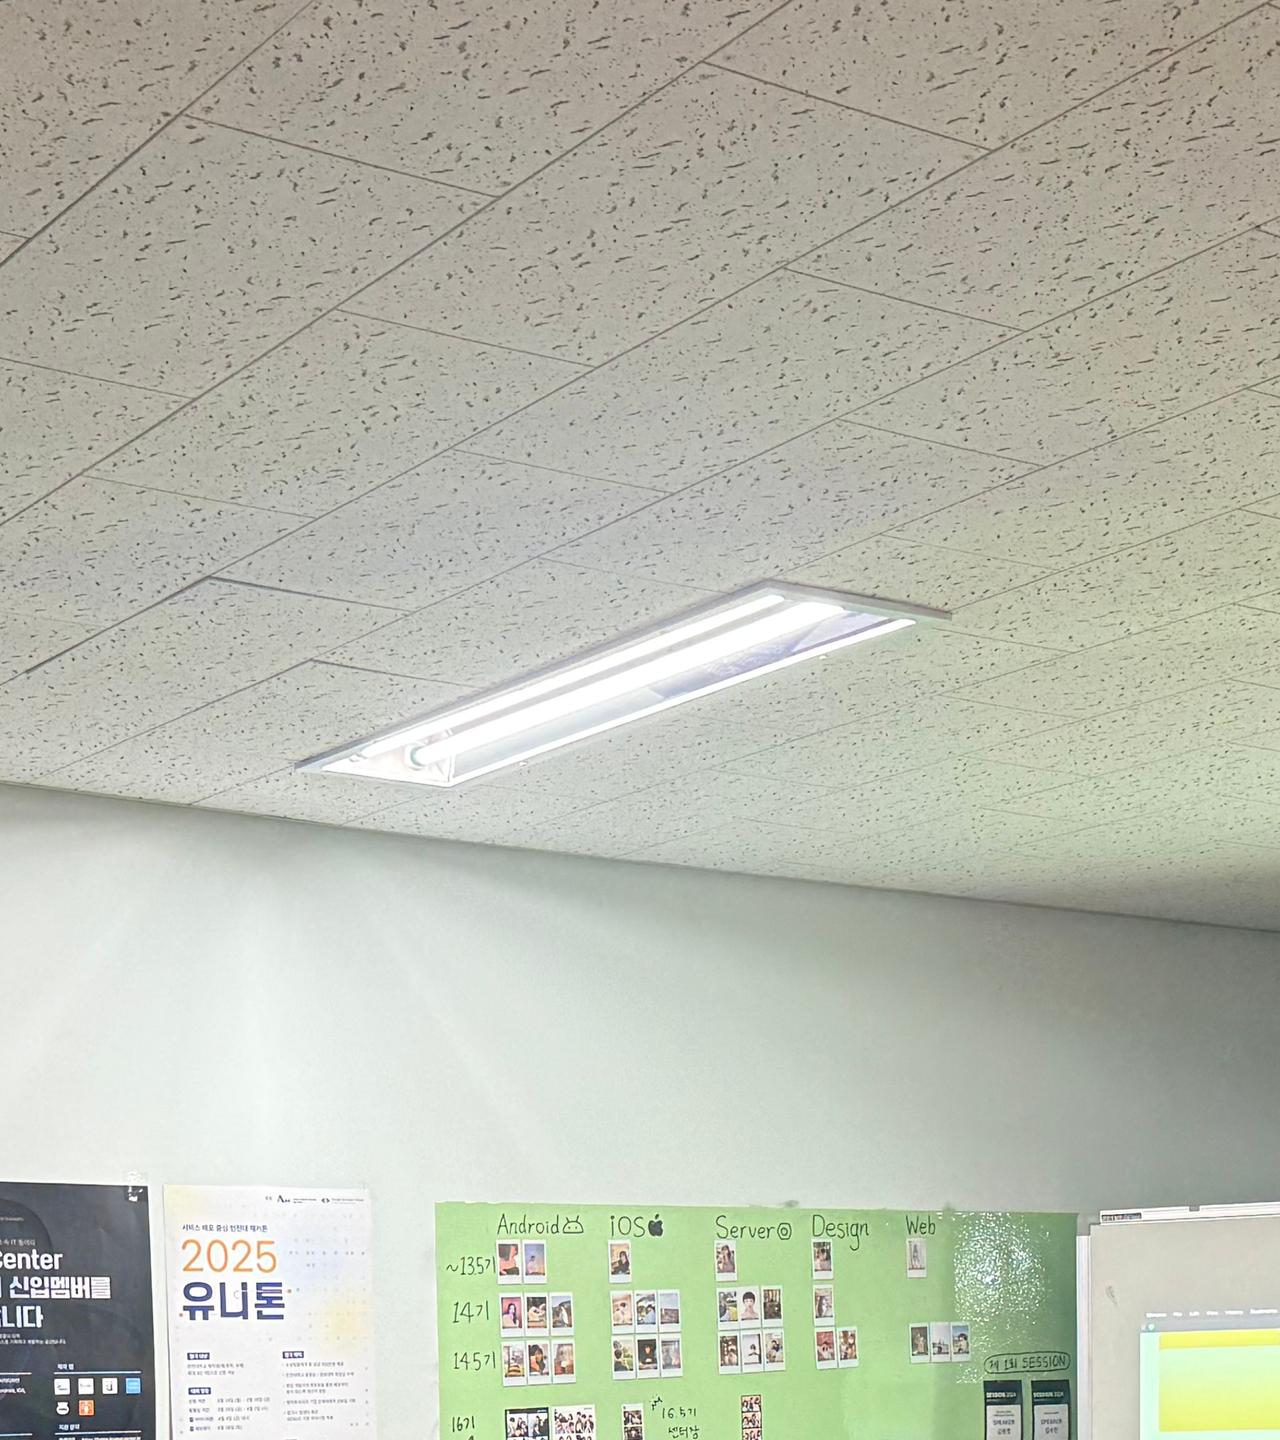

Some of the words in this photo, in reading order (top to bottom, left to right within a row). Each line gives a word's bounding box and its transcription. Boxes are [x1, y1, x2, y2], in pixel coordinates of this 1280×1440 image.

[497, 1213, 559, 1235] Android
[610, 1215, 645, 1237] iOS
[715, 1215, 775, 1240] Server
[812, 1214, 869, 1251] Design
[905, 1215, 936, 1235] Web
[181, 1239, 277, 1273] 2025
[9, 1276, 111, 1299] 신입멤버를
[183, 1281, 285, 1321] 유니톤
[452, 1301, 490, 1324] 14기
[1022, 1354, 1067, 1369] SESSION
[452, 1416, 475, 1432] 16기
[668, 1425, 700, 1439] 센터장
